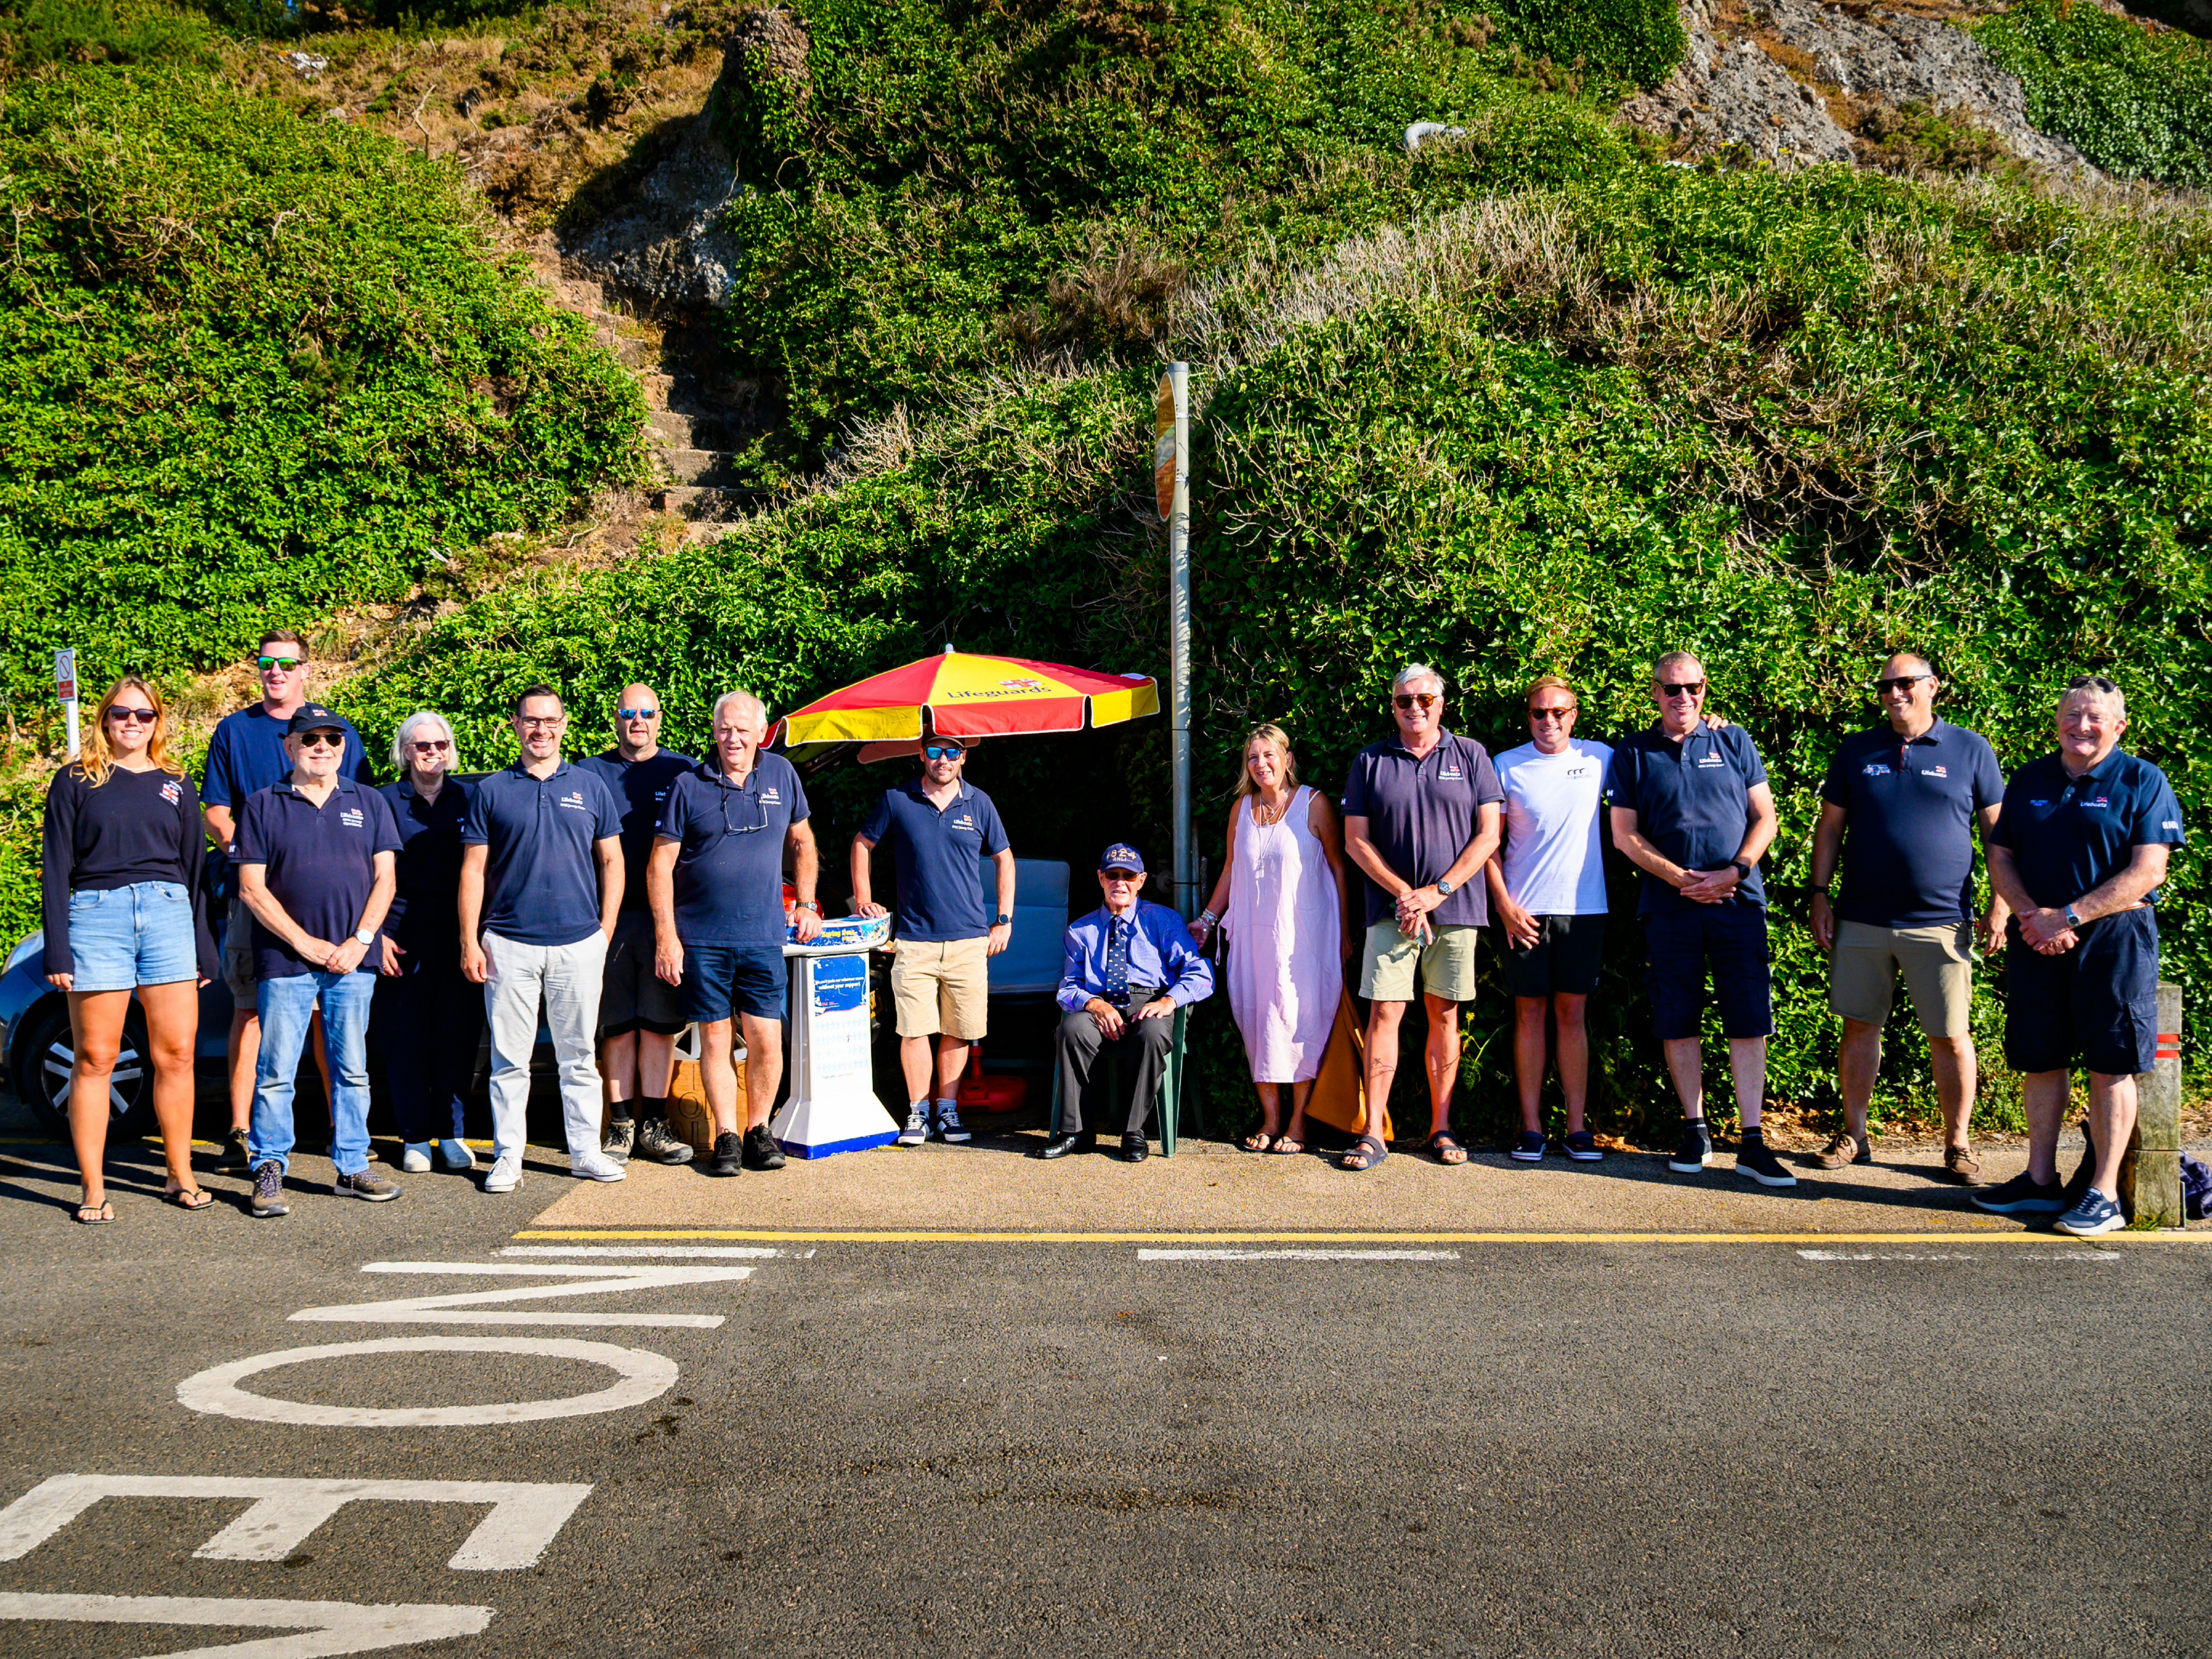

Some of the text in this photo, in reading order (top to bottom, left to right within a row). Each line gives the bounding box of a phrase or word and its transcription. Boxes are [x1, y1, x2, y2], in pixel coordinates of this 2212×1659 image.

[947, 686, 1052, 699] Lifeguards
[1921, 770, 1947, 778] Lifeboats
[1106, 848, 1136, 860] 1824
[821, 930, 841, 938] Saving
[175, 1261, 758, 1428] NO
